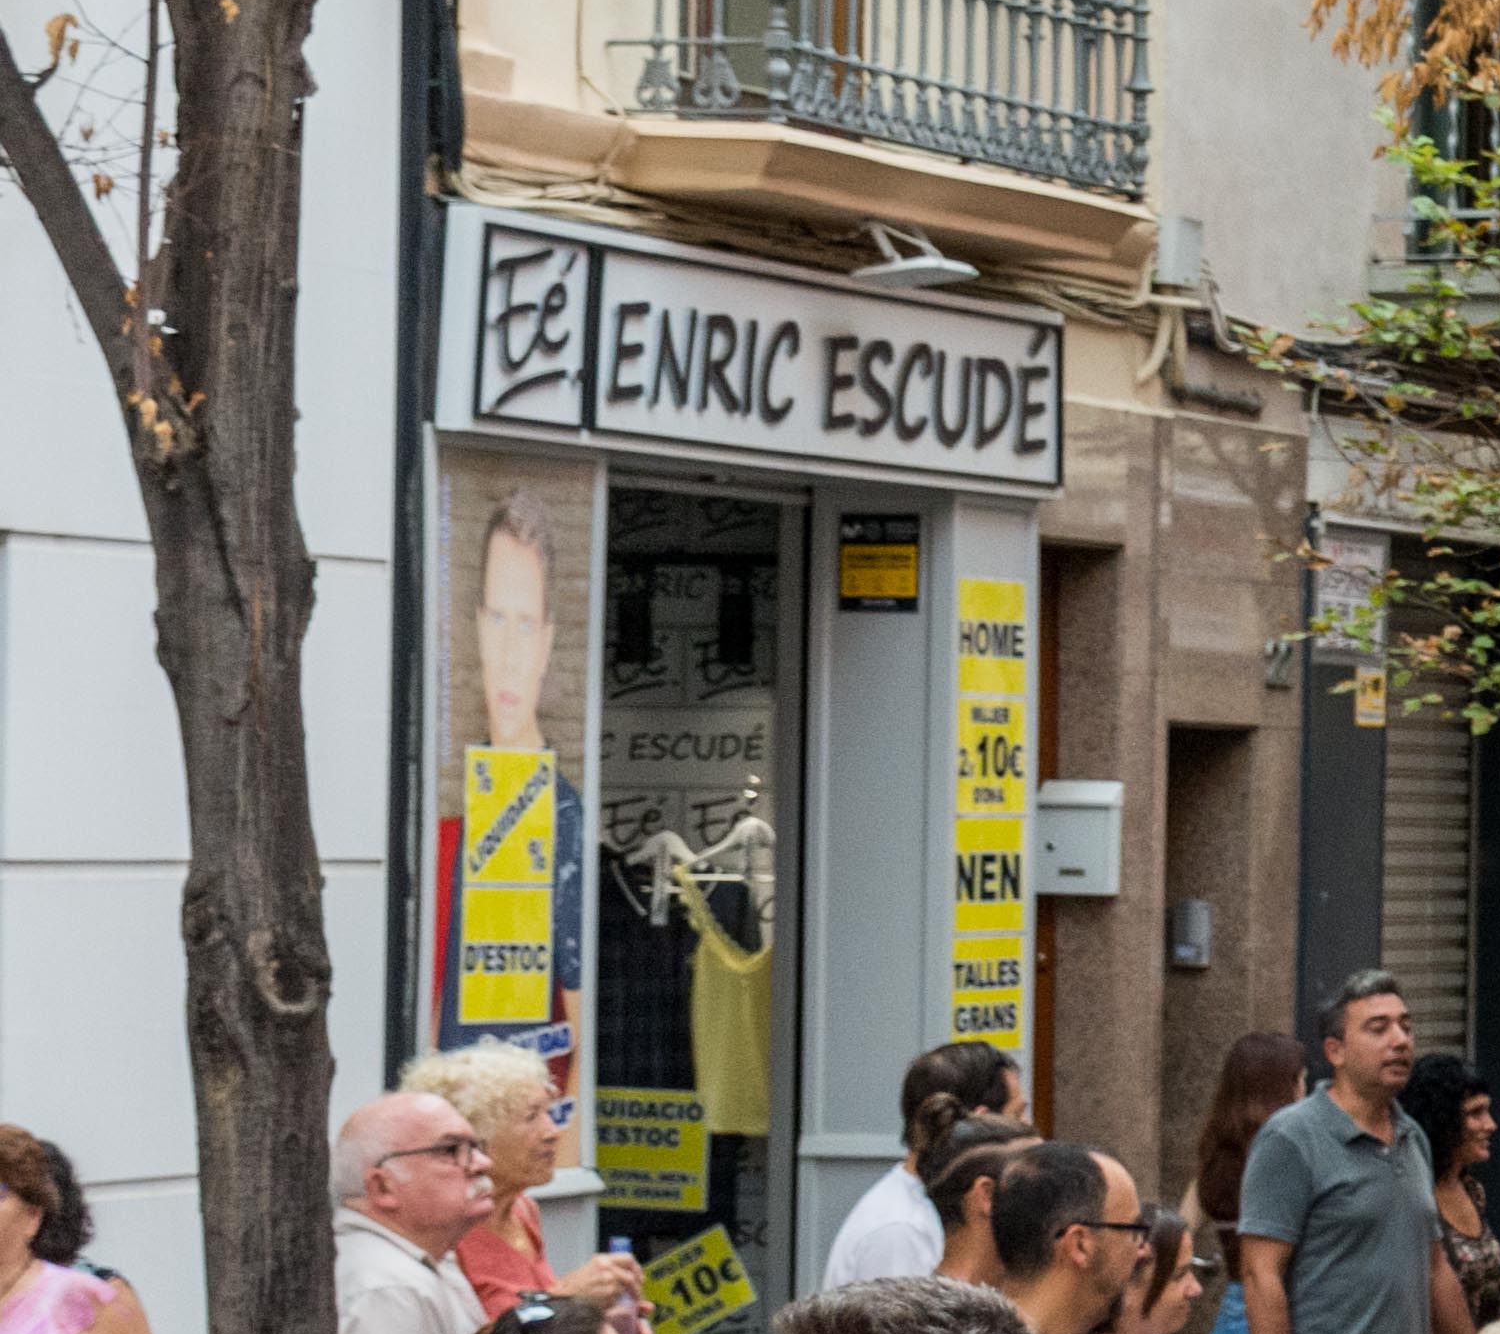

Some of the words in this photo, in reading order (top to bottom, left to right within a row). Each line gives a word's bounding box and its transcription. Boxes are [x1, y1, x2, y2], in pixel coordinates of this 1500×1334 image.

[605, 300, 801, 427] ENRIC
[822, 325, 1051, 456] ESCUDÉ
[959, 620, 1026, 660] HOME
[628, 723, 764, 762] ESCUDÉ
[955, 853, 1022, 903] NEN
[464, 943, 549, 974] D'ESTOC
[955, 960, 1021, 991] TALLES
[954, 1003, 1017, 1033] GRANS
